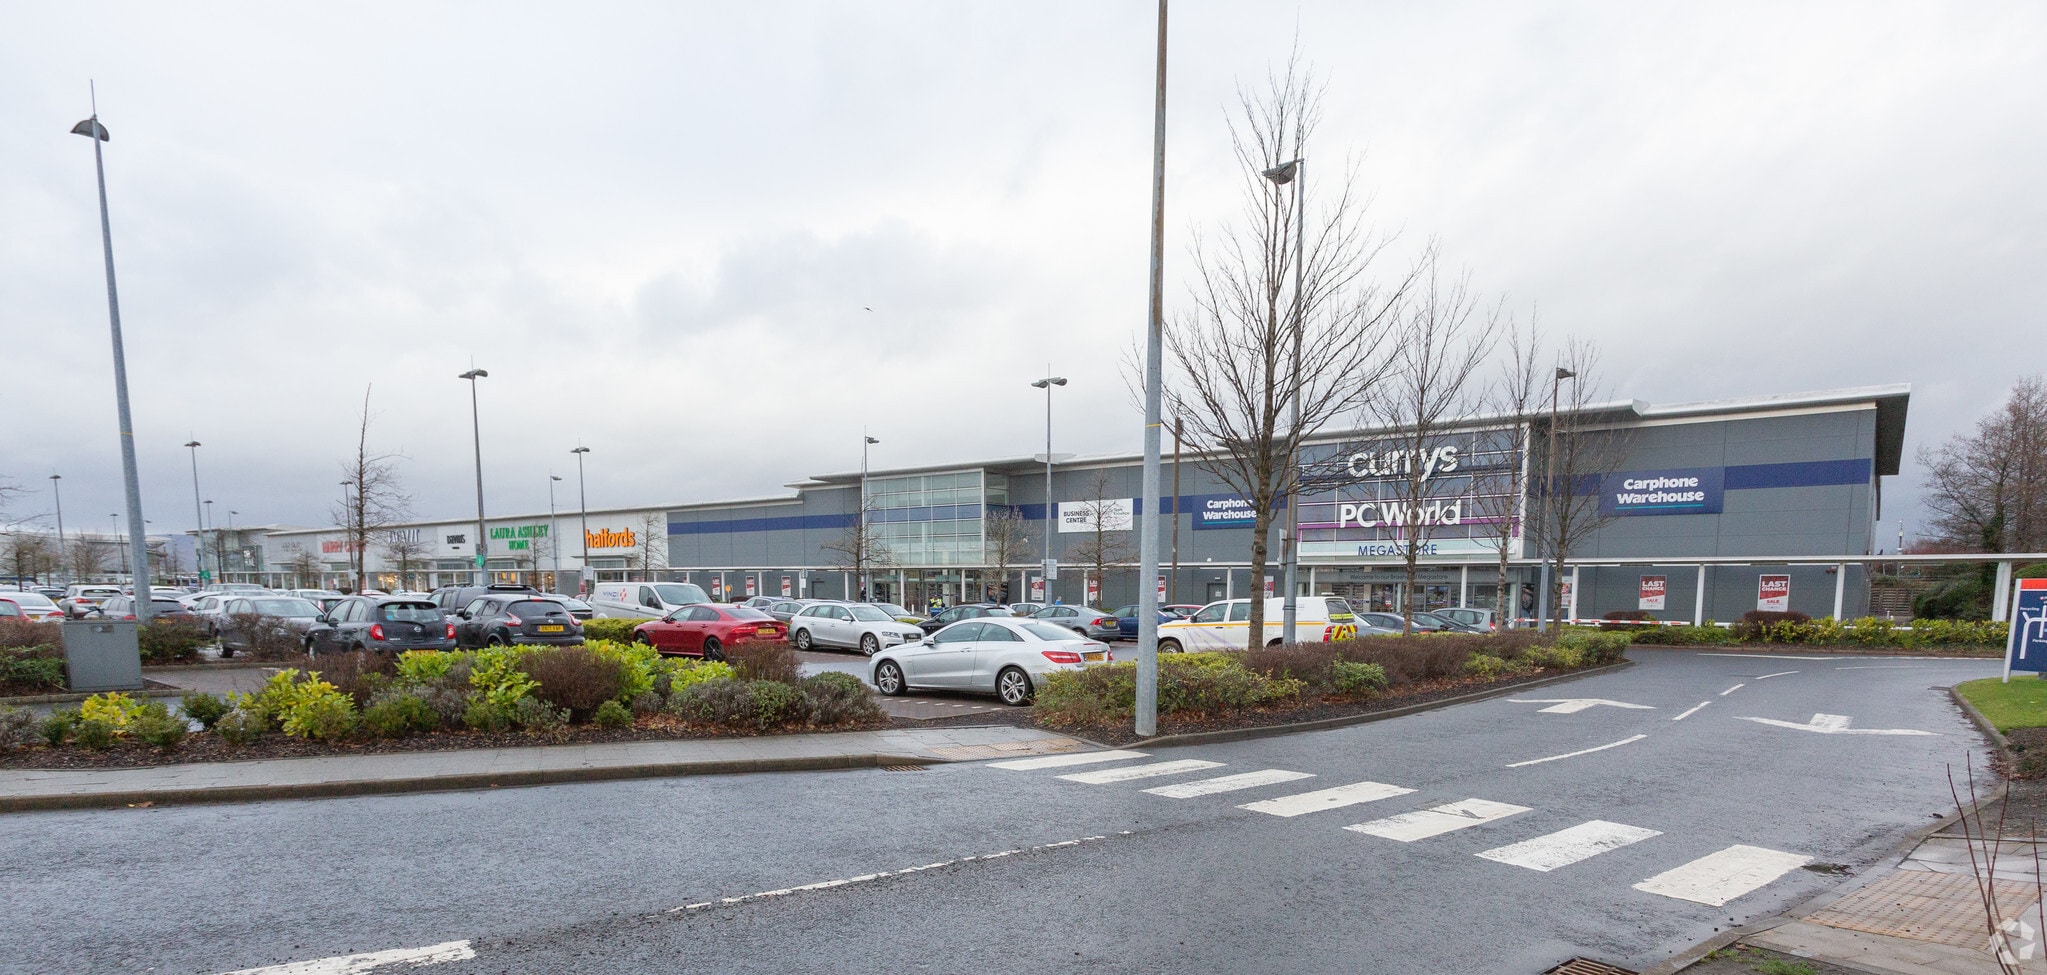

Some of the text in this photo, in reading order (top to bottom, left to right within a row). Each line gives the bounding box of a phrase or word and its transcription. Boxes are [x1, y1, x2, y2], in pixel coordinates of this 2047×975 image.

[1347, 446, 1458, 482] currys
[1623, 476, 1698, 491] Carphone
[1616, 490, 1704, 504] Warehouse
[1203, 510, 1257, 520] Warehouse
[1340, 499, 1461, 528] PC World
[490, 525, 549, 539] LAURA ASHLEY
[586, 527, 636, 549] halfords
[508, 540, 529, 550] HOME
